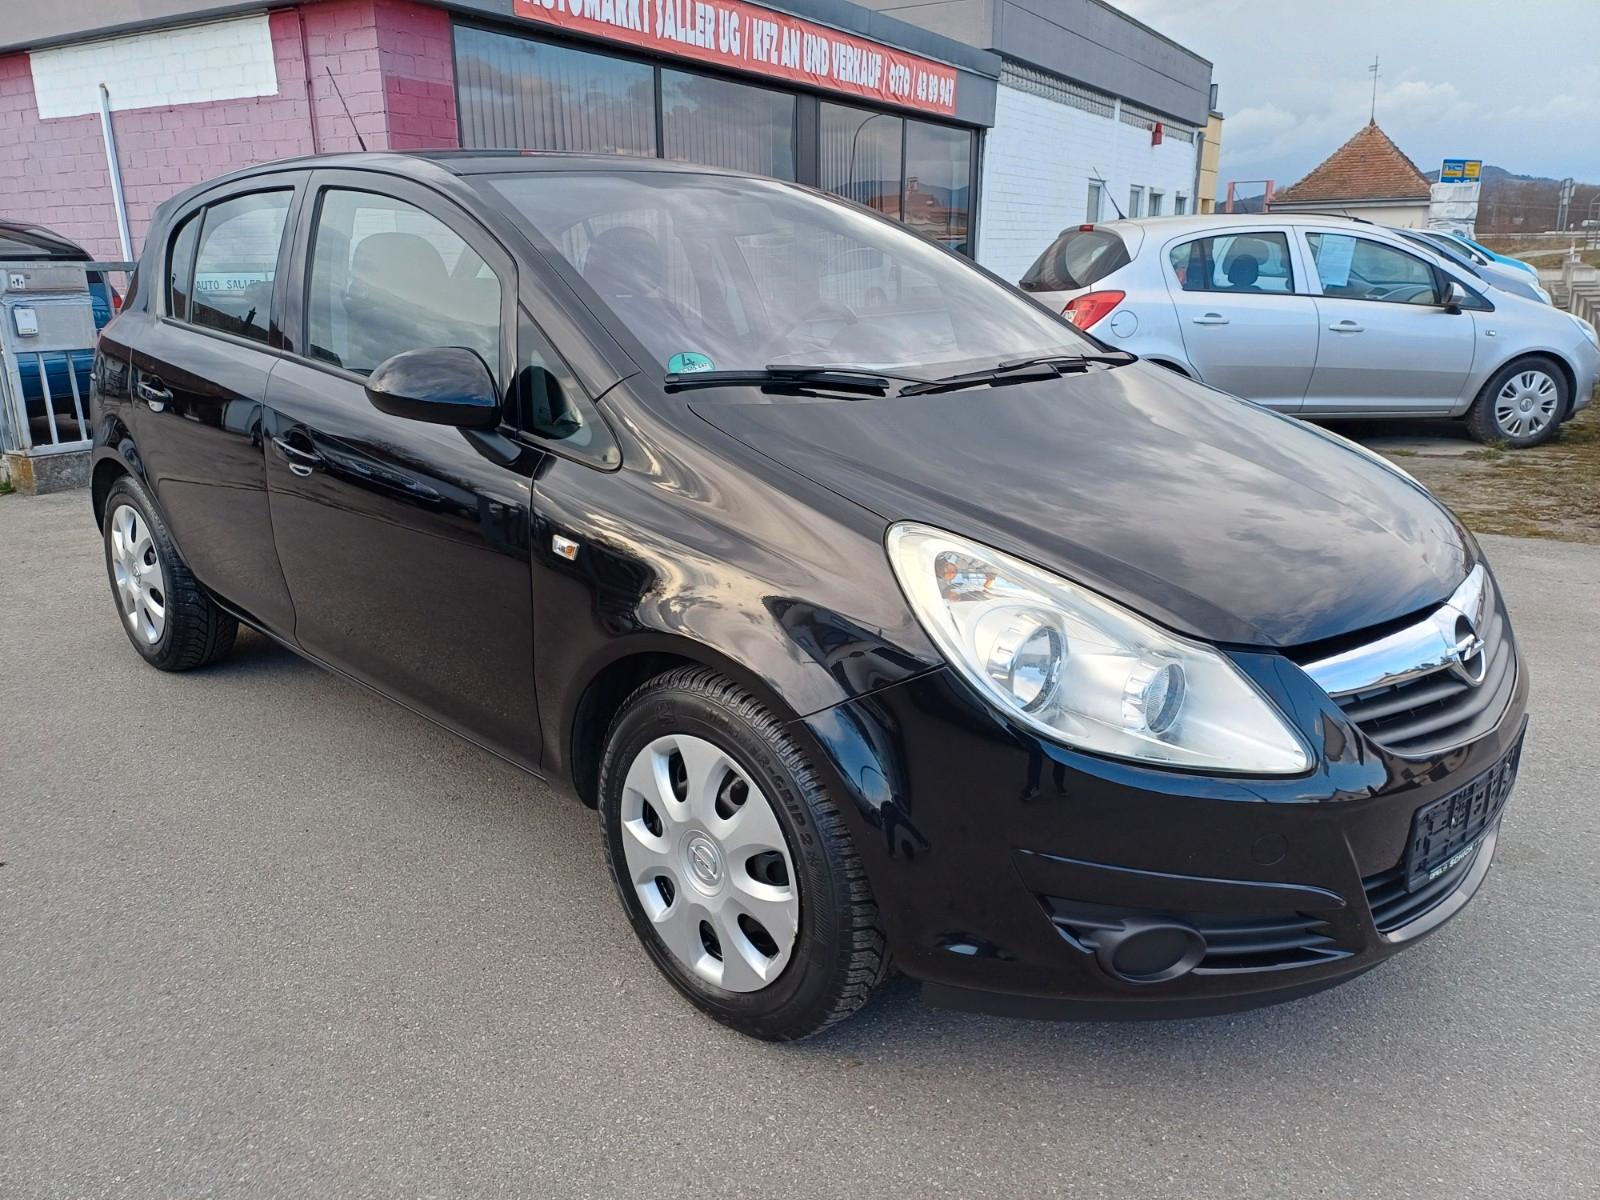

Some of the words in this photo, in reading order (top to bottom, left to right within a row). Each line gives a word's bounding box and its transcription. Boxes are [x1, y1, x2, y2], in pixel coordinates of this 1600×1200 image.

[655, 0, 715, 50] SALLER
[718, 9, 740, 57] UG
[753, 18, 778, 65] KFZ
[780, 26, 800, 70] AN
[803, 33, 829, 76] UND
[832, 41, 882, 89] VERKAUF
[916, 70, 928, 101] 43
[940, 75, 954, 108] 947
[196, 280, 220, 289] AUTO
